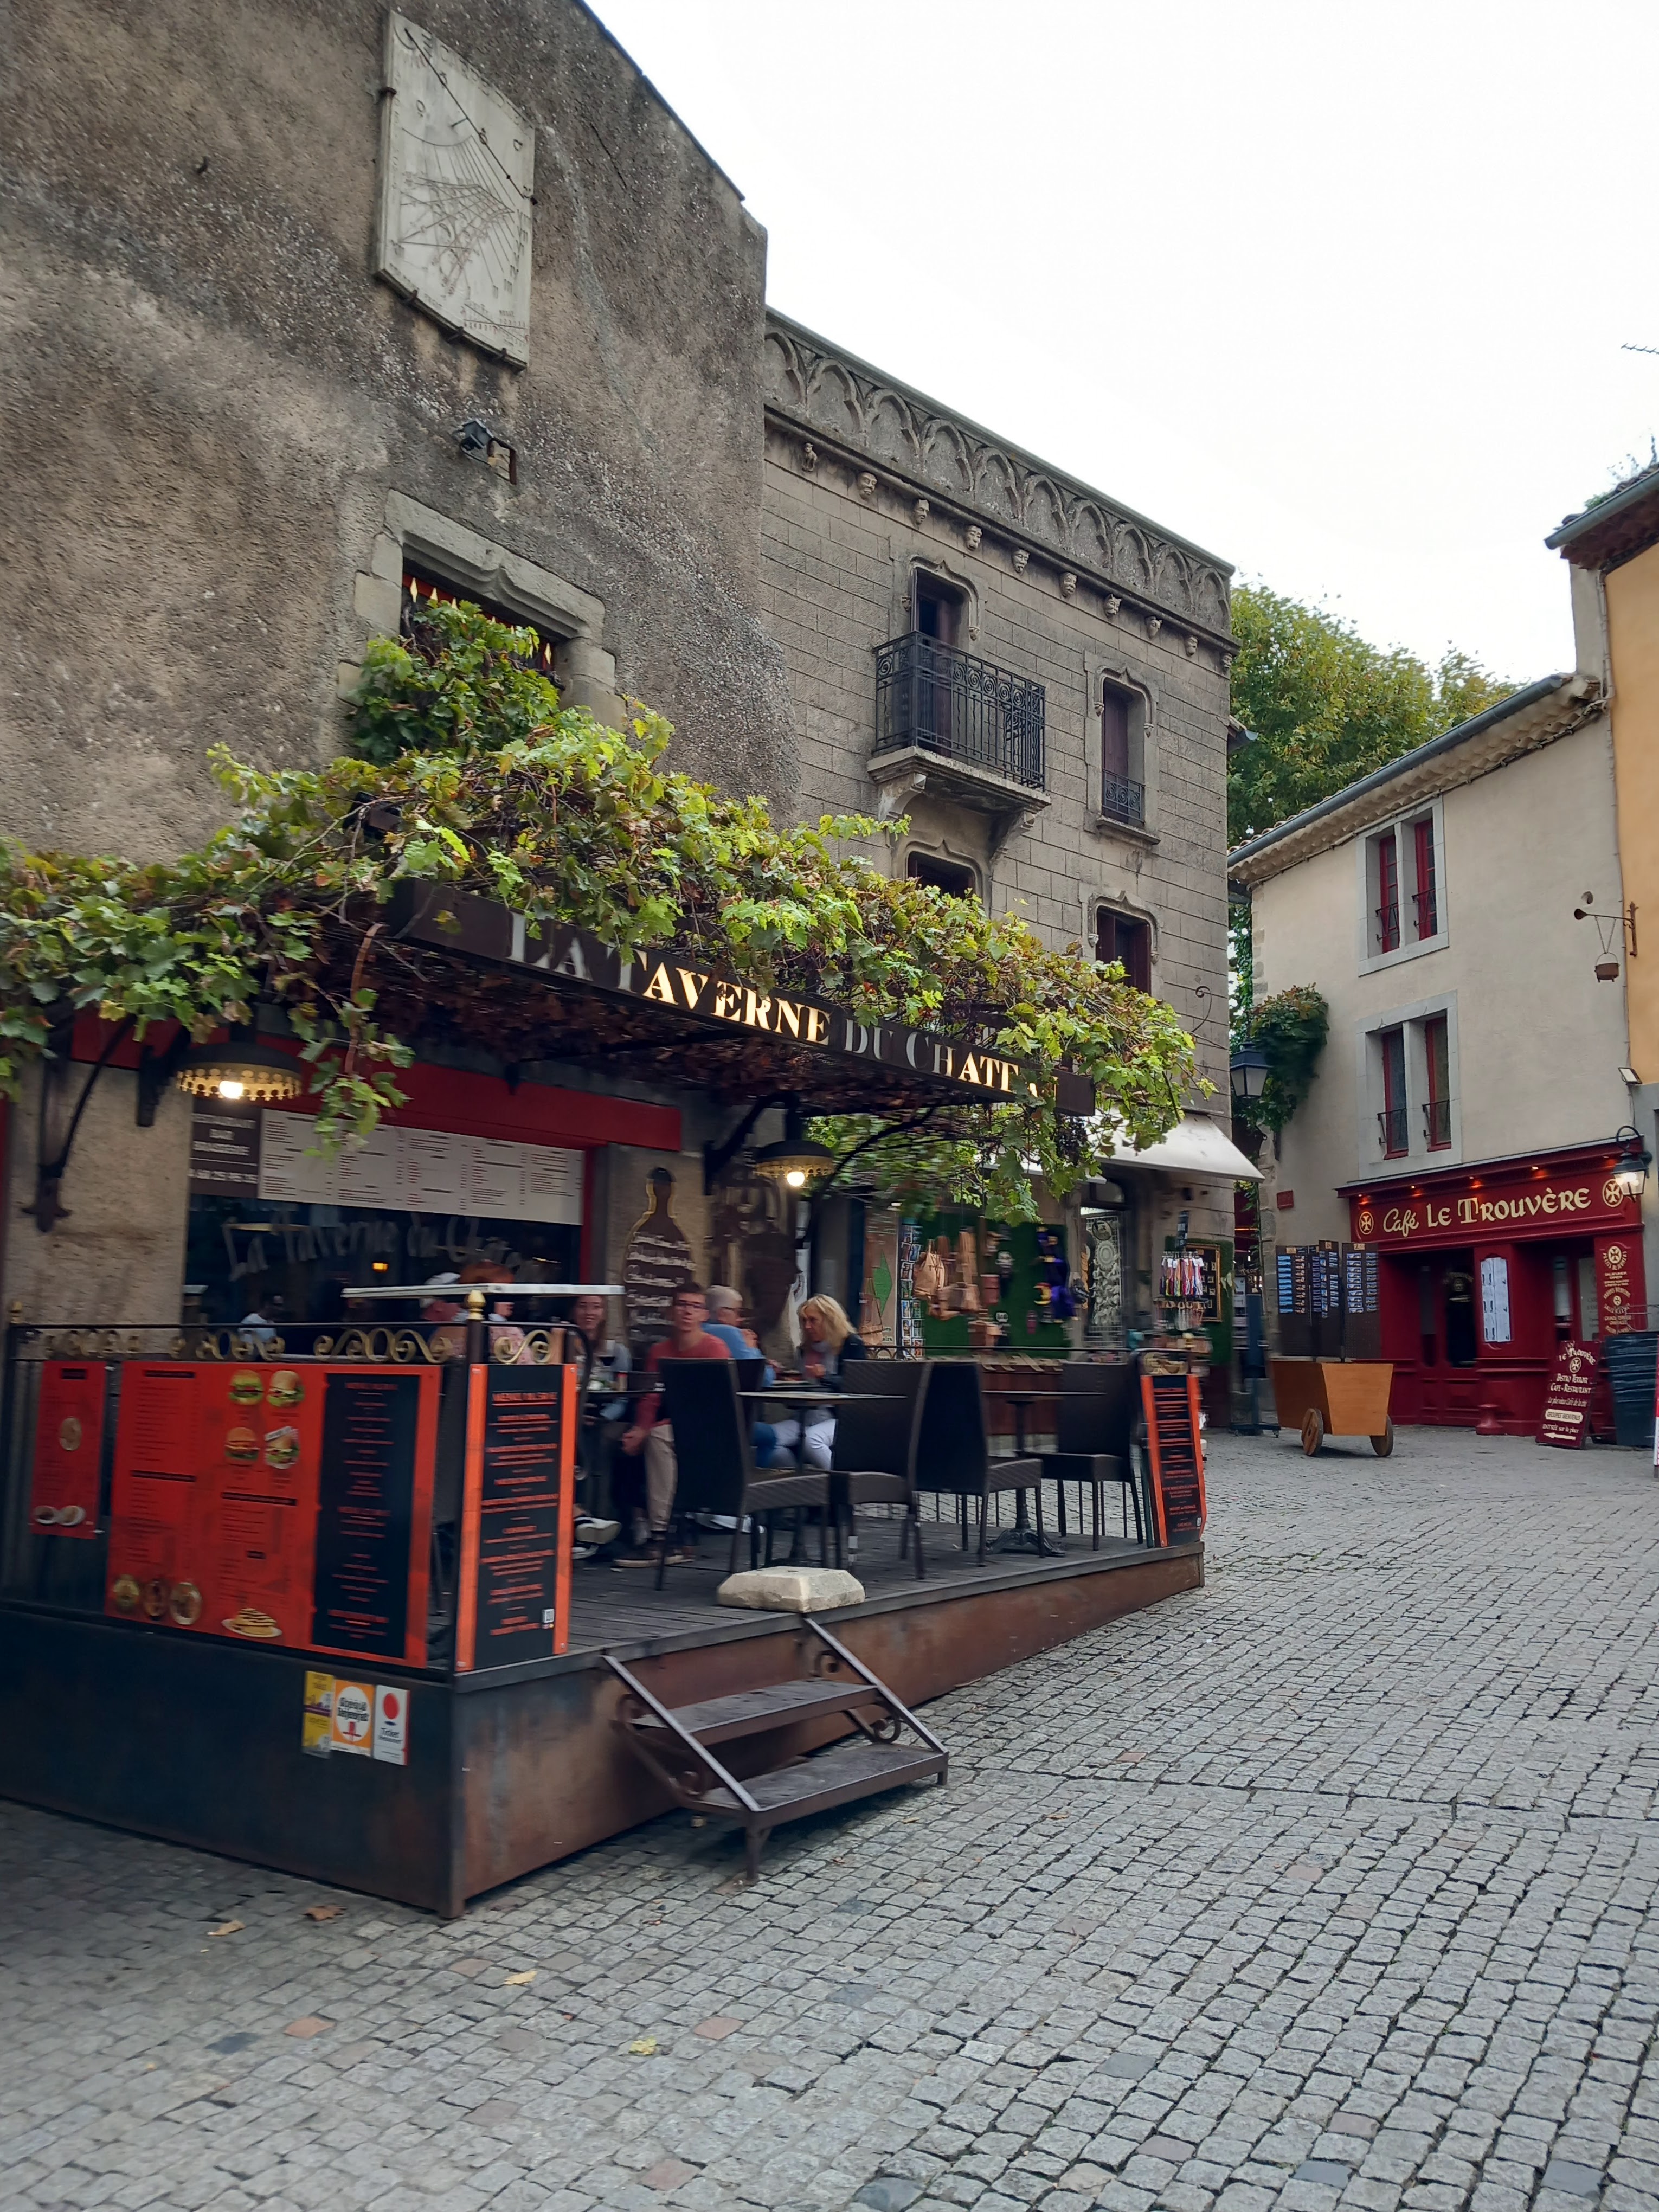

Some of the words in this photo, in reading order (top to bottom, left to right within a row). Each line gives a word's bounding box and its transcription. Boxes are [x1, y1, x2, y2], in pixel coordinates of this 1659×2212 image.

[606, 941, 832, 1045] TAVERNE
[844, 1018, 893, 1061] DU
[1383, 1208, 1419, 1237] Café
